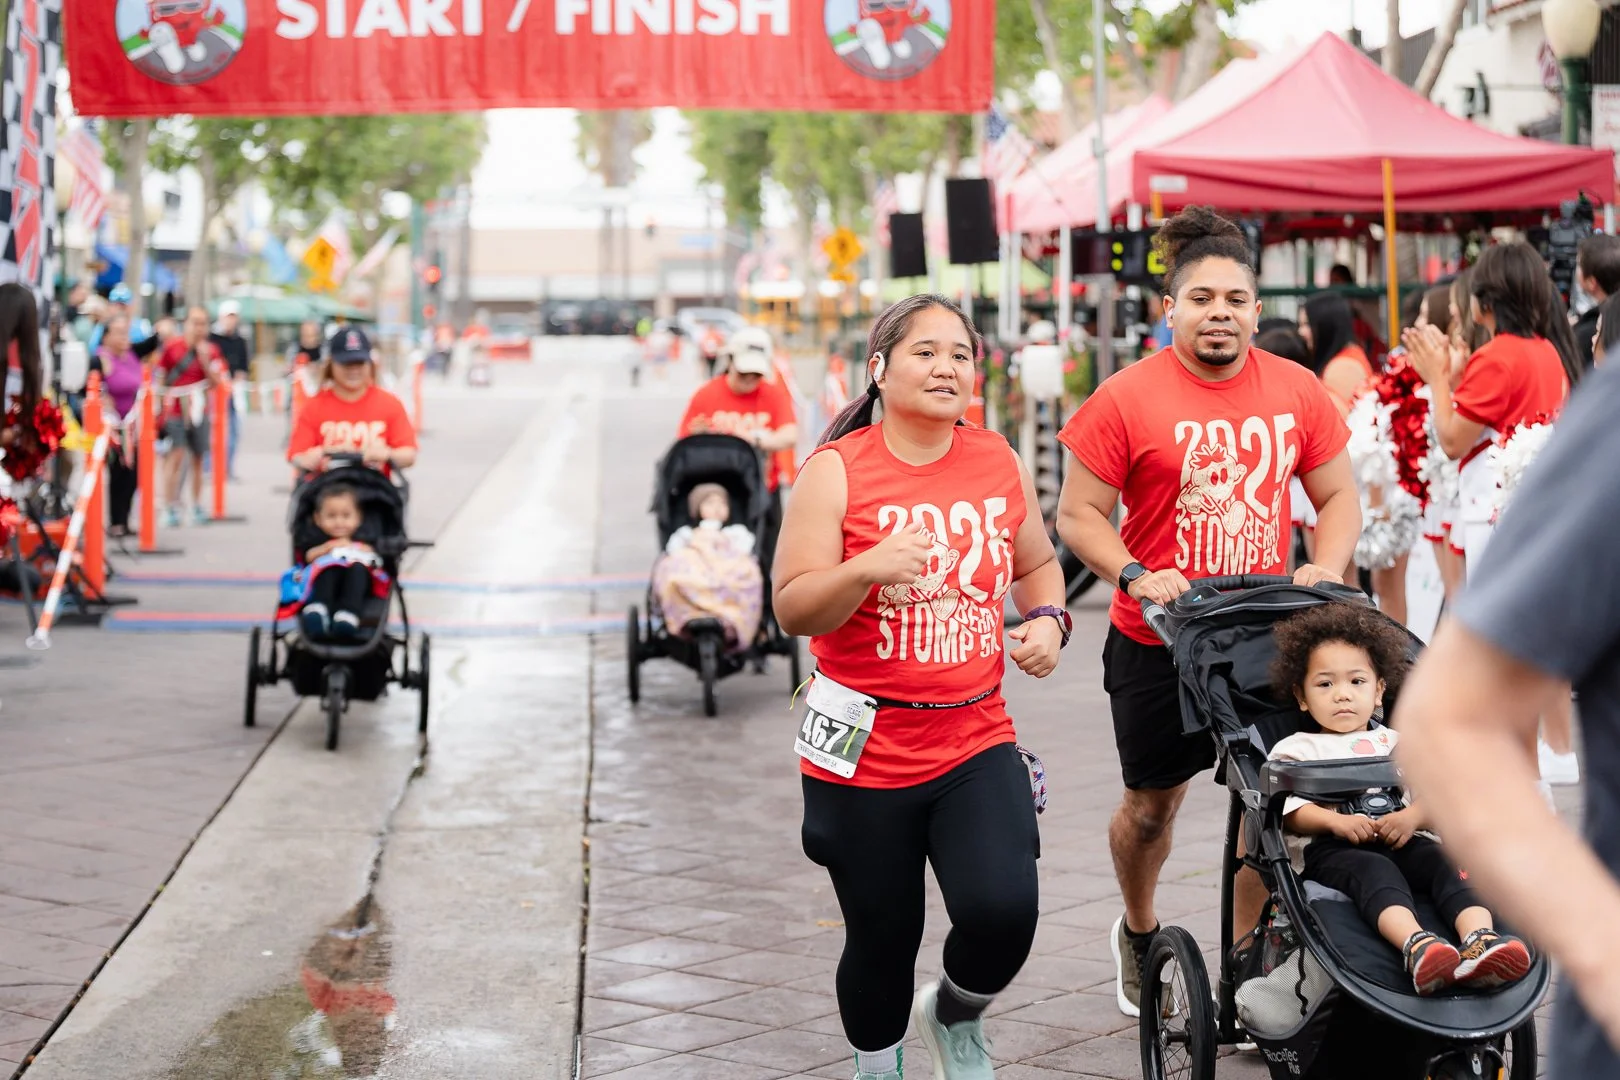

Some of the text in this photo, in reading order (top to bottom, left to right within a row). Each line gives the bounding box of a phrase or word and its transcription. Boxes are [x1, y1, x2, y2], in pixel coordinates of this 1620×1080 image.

[275, 0, 483, 40] START
[555, 0, 790, 36] FINISH
[1175, 512, 1281, 575] STOMP 5K
[876, 601, 1001, 663] STOMP 5K
[802, 709, 850, 753] 467
[1262, 1048, 1298, 1062] RaceTec
